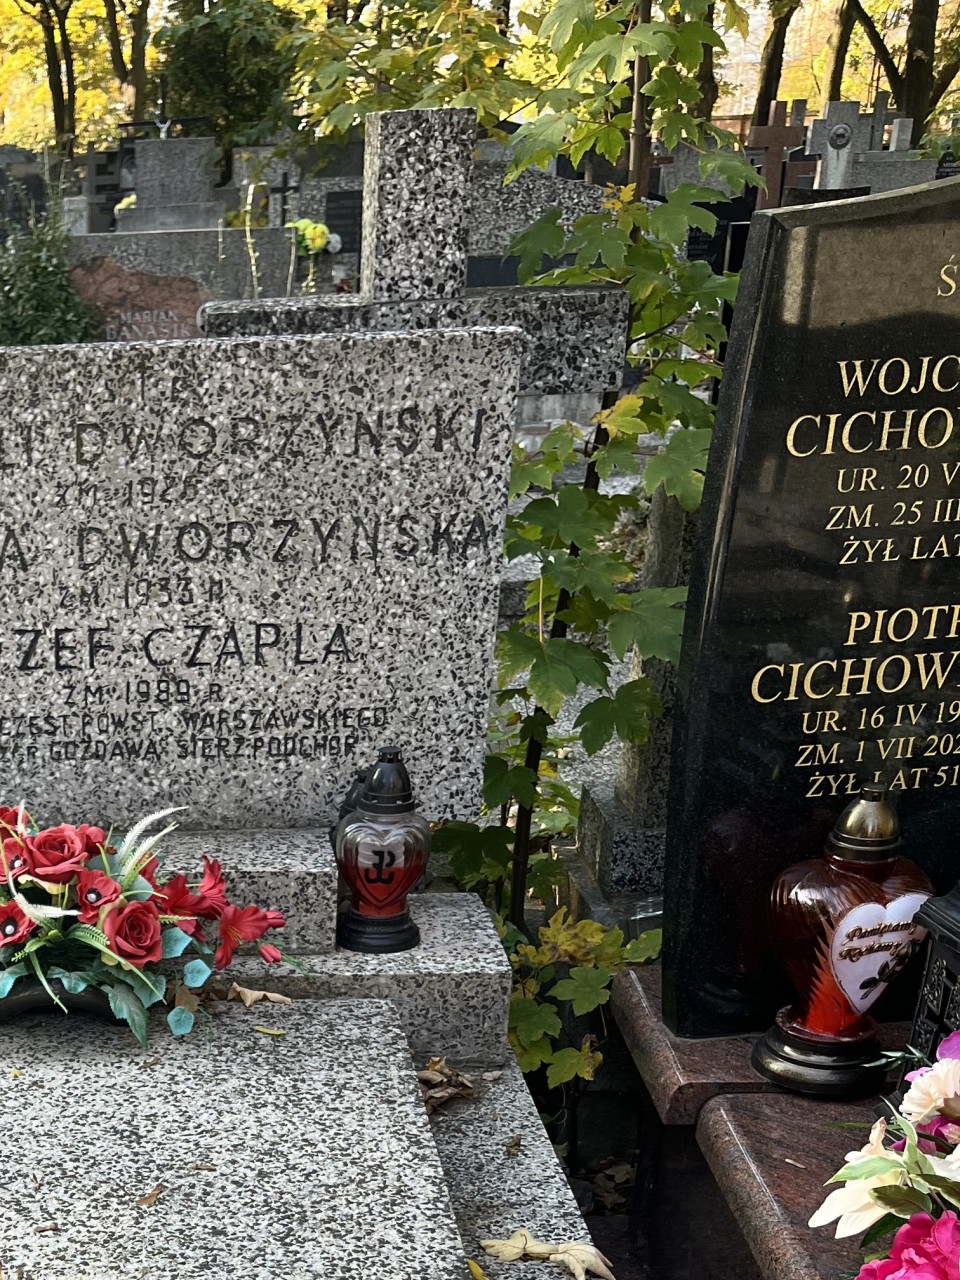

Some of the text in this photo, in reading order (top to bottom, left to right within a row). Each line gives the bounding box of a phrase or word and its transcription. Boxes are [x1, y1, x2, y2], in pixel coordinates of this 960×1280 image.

[837, 355, 960, 397] WOJC
[786, 406, 960, 458] CICHO
[837, 468, 885, 493] UR.
[896, 463, 929, 488] 20
[825, 503, 879, 530] ZM.
[890, 500, 923, 526] 25
[839, 535, 900, 565] ŻYŁ
[143, 622, 358, 668] CZAPLA
[125, 679, 190, 704] 1989
[751, 651, 960, 703] CICHOW
[180, 706, 388, 732] WARSZAWSKIEGO
[802, 710, 847, 734] UR.
[858, 706, 886, 730] 16
[894, 703, 927, 727] IV
[794, 742, 844, 767] ZM.
[856, 740, 865, 762] 1
[877, 736, 917, 760] VII
[805, 771, 861, 798] ŻYŁ
[934, 764, 960, 788] 51
